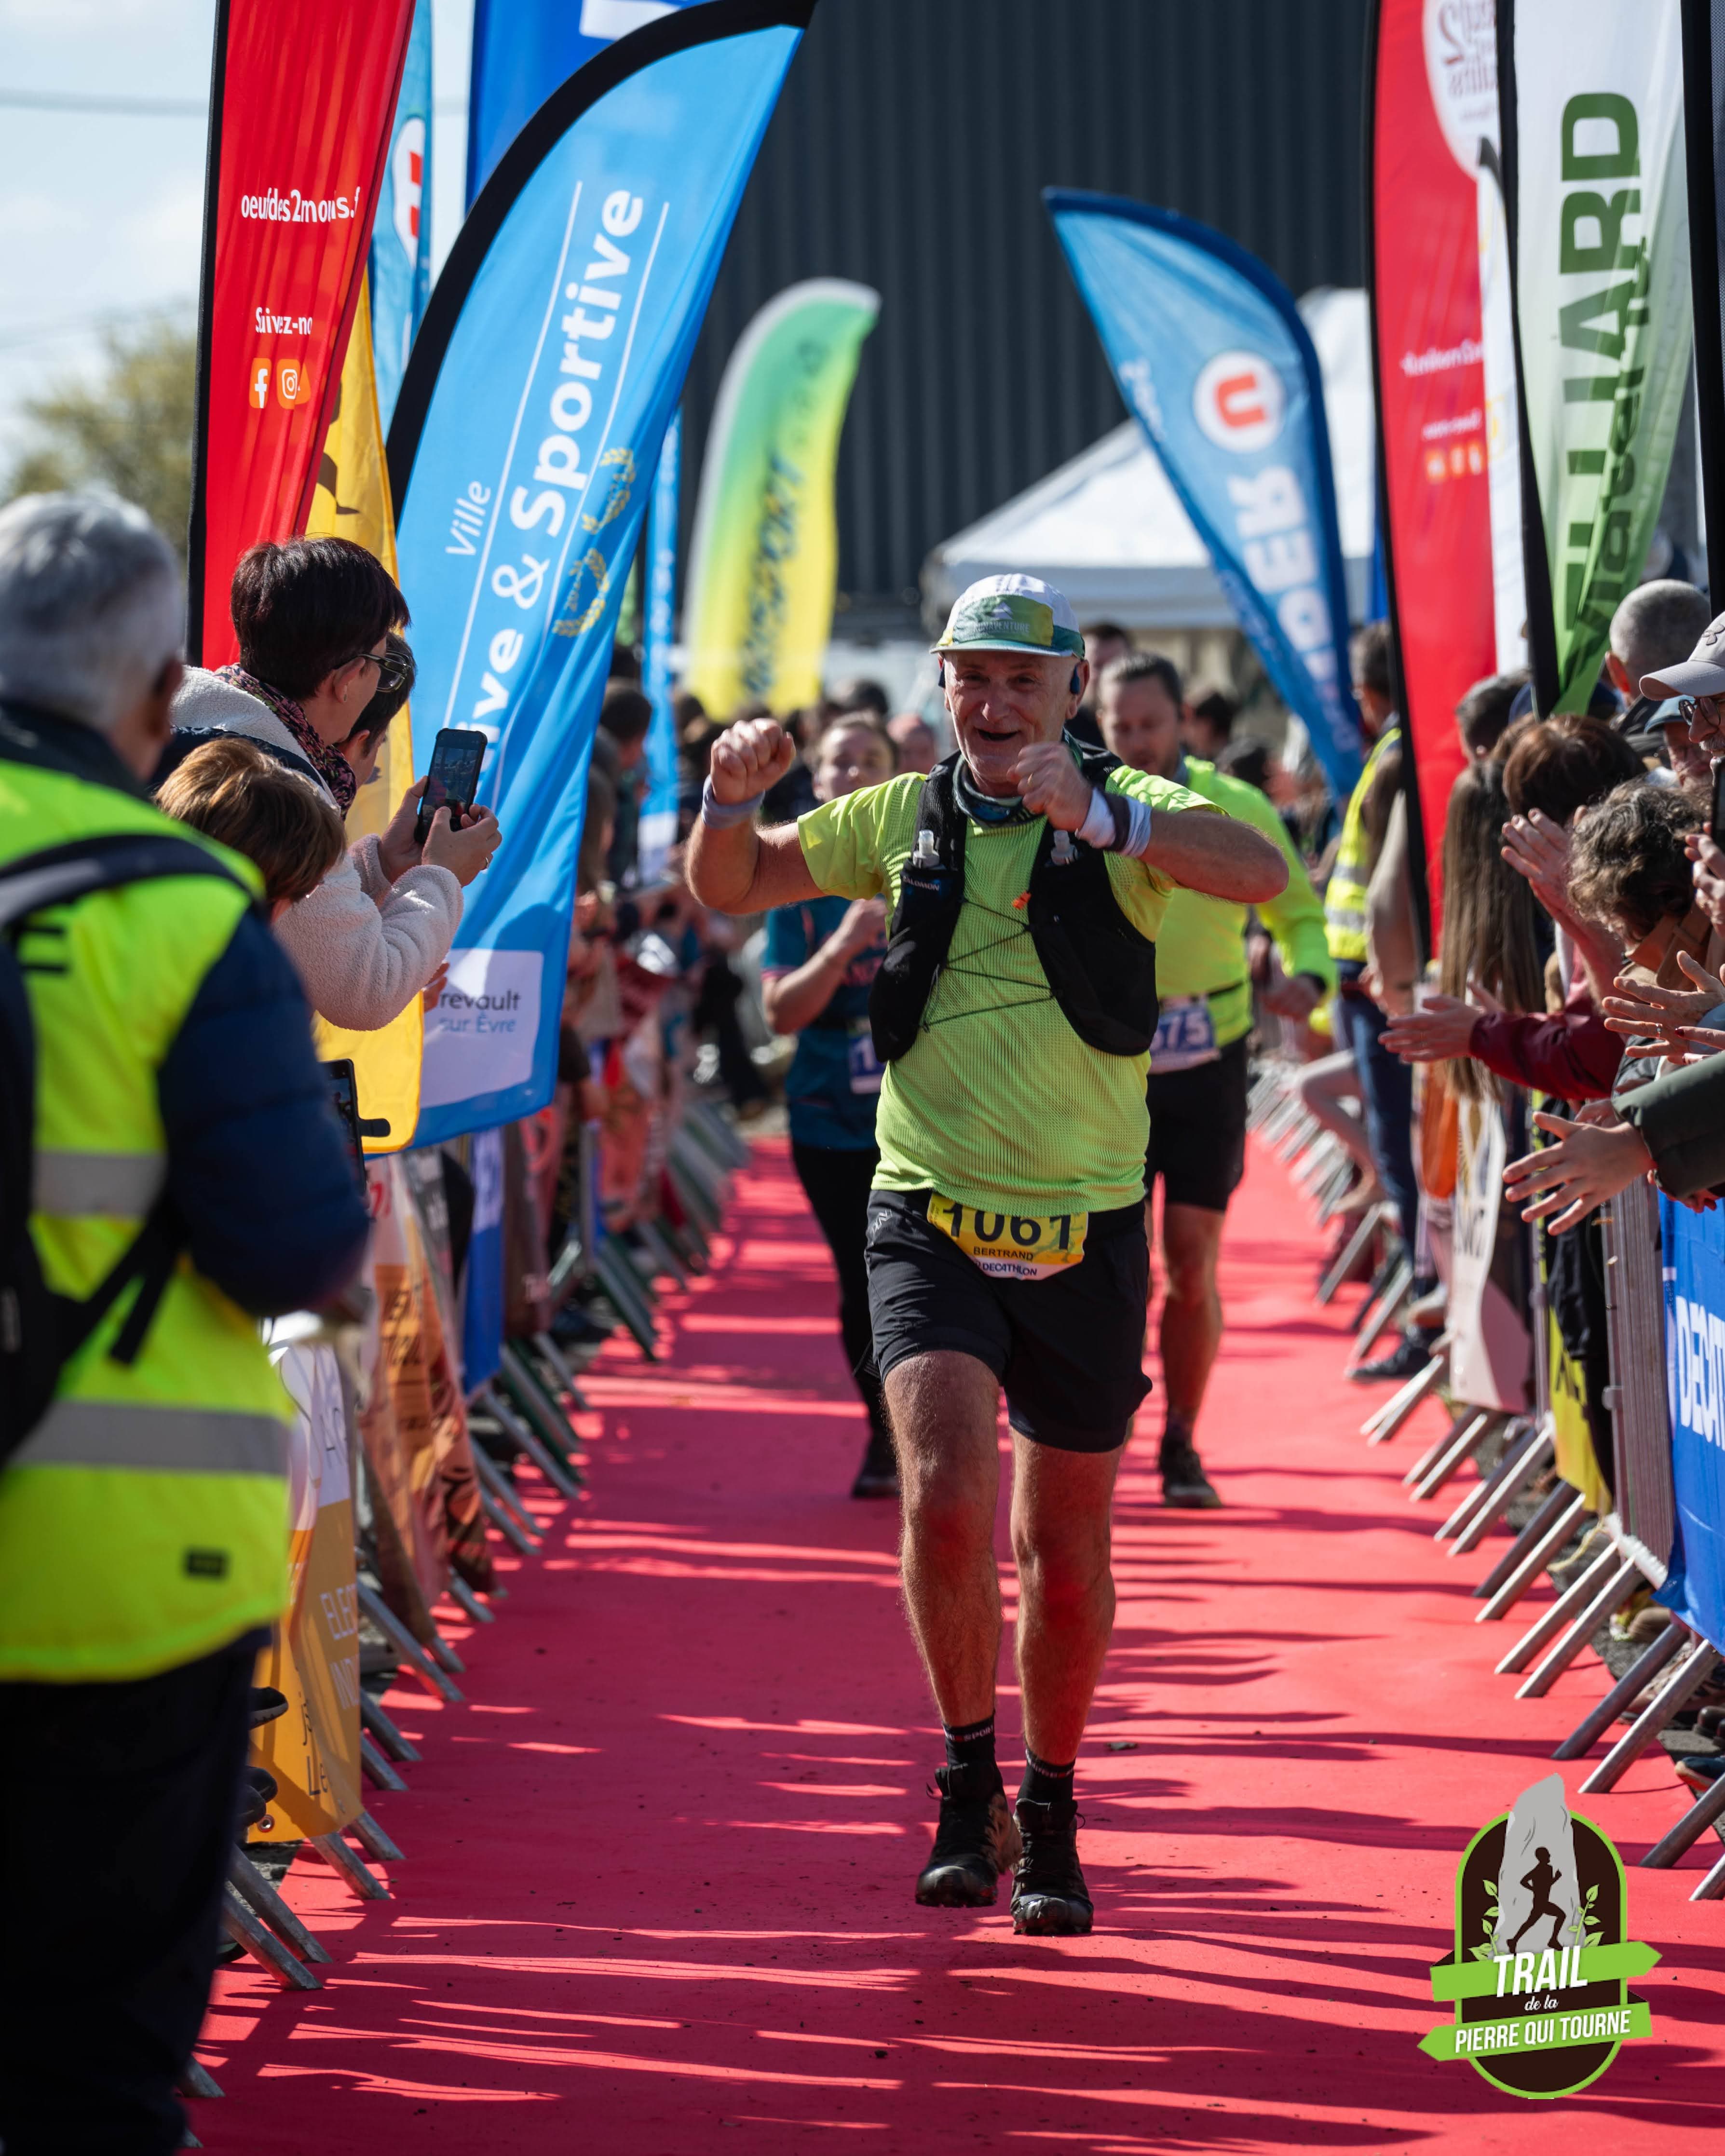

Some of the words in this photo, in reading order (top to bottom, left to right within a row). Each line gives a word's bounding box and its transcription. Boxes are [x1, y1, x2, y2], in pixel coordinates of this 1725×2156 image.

[509, 190, 645, 538] Sportive
[445, 481, 491, 556] Ville
[491, 554, 550, 610] &
[455, 628, 524, 776] ive
[439, 989, 520, 1012] revault
[438, 1017, 469, 1032] sur
[943, 1203, 1071, 1250] 1061
[973, 1246, 1033, 1261] BERTRAND
[982, 1262, 1037, 1276] DECATHLON
